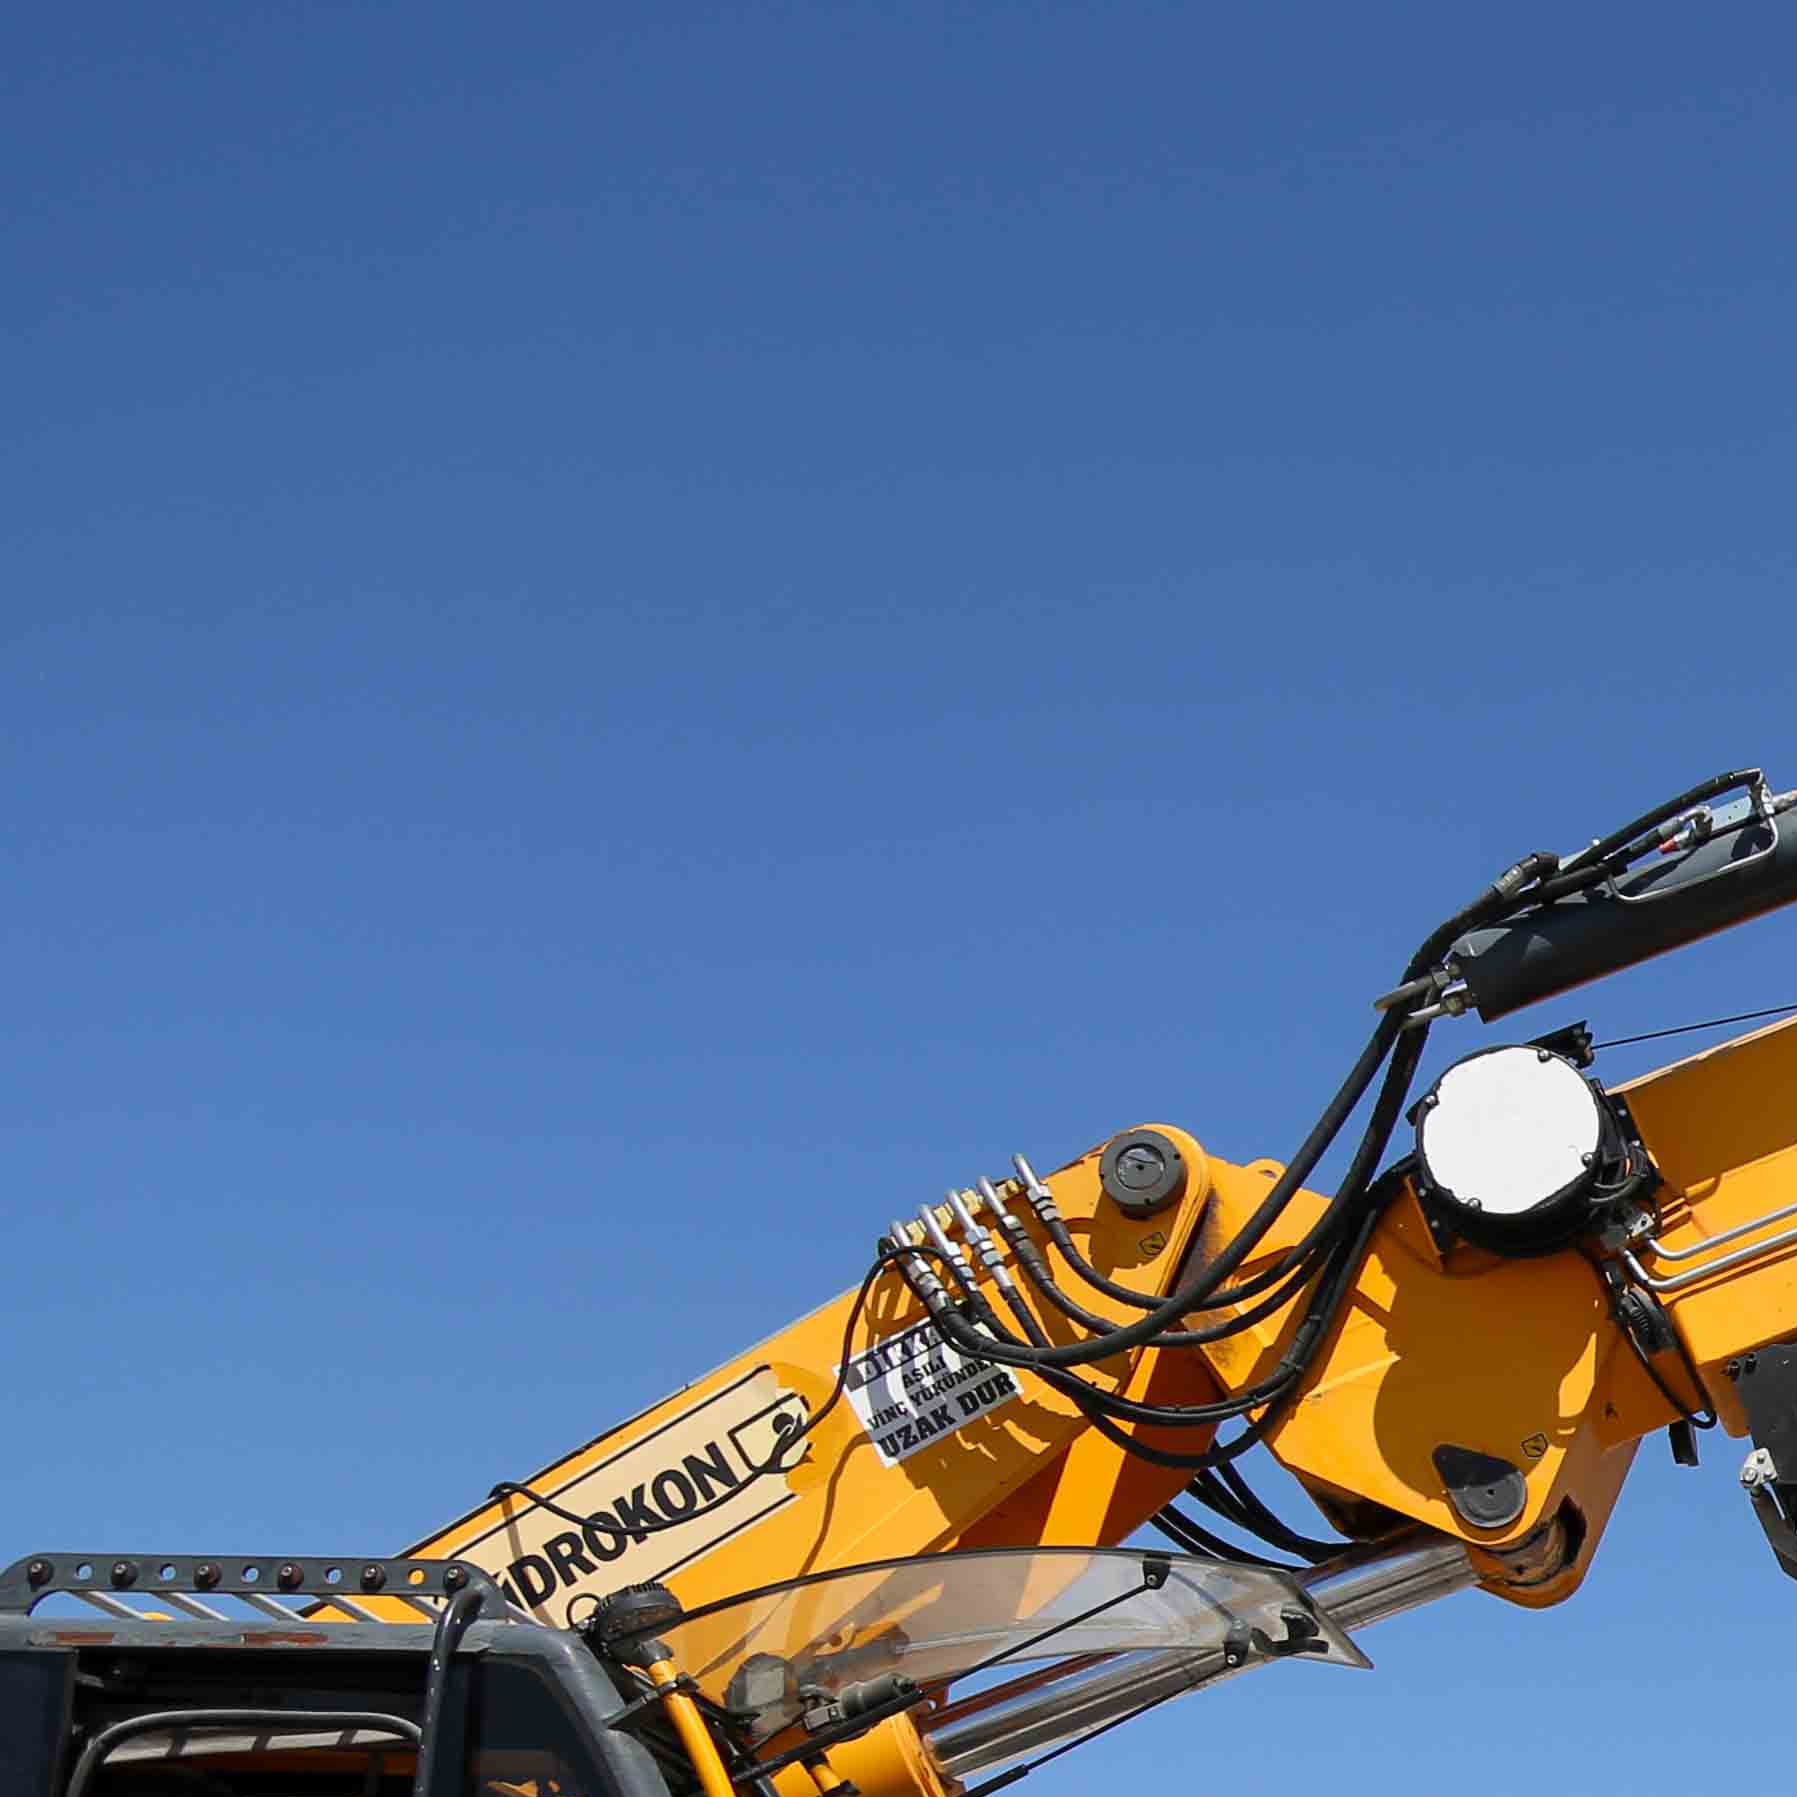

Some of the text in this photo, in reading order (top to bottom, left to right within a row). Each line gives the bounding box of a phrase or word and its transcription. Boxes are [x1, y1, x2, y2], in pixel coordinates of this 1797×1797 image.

[857, 1324, 943, 1380] DİKKA
[867, 1400, 911, 1431] VİNÇ
[877, 1371, 1017, 1458] UZAK DUR
